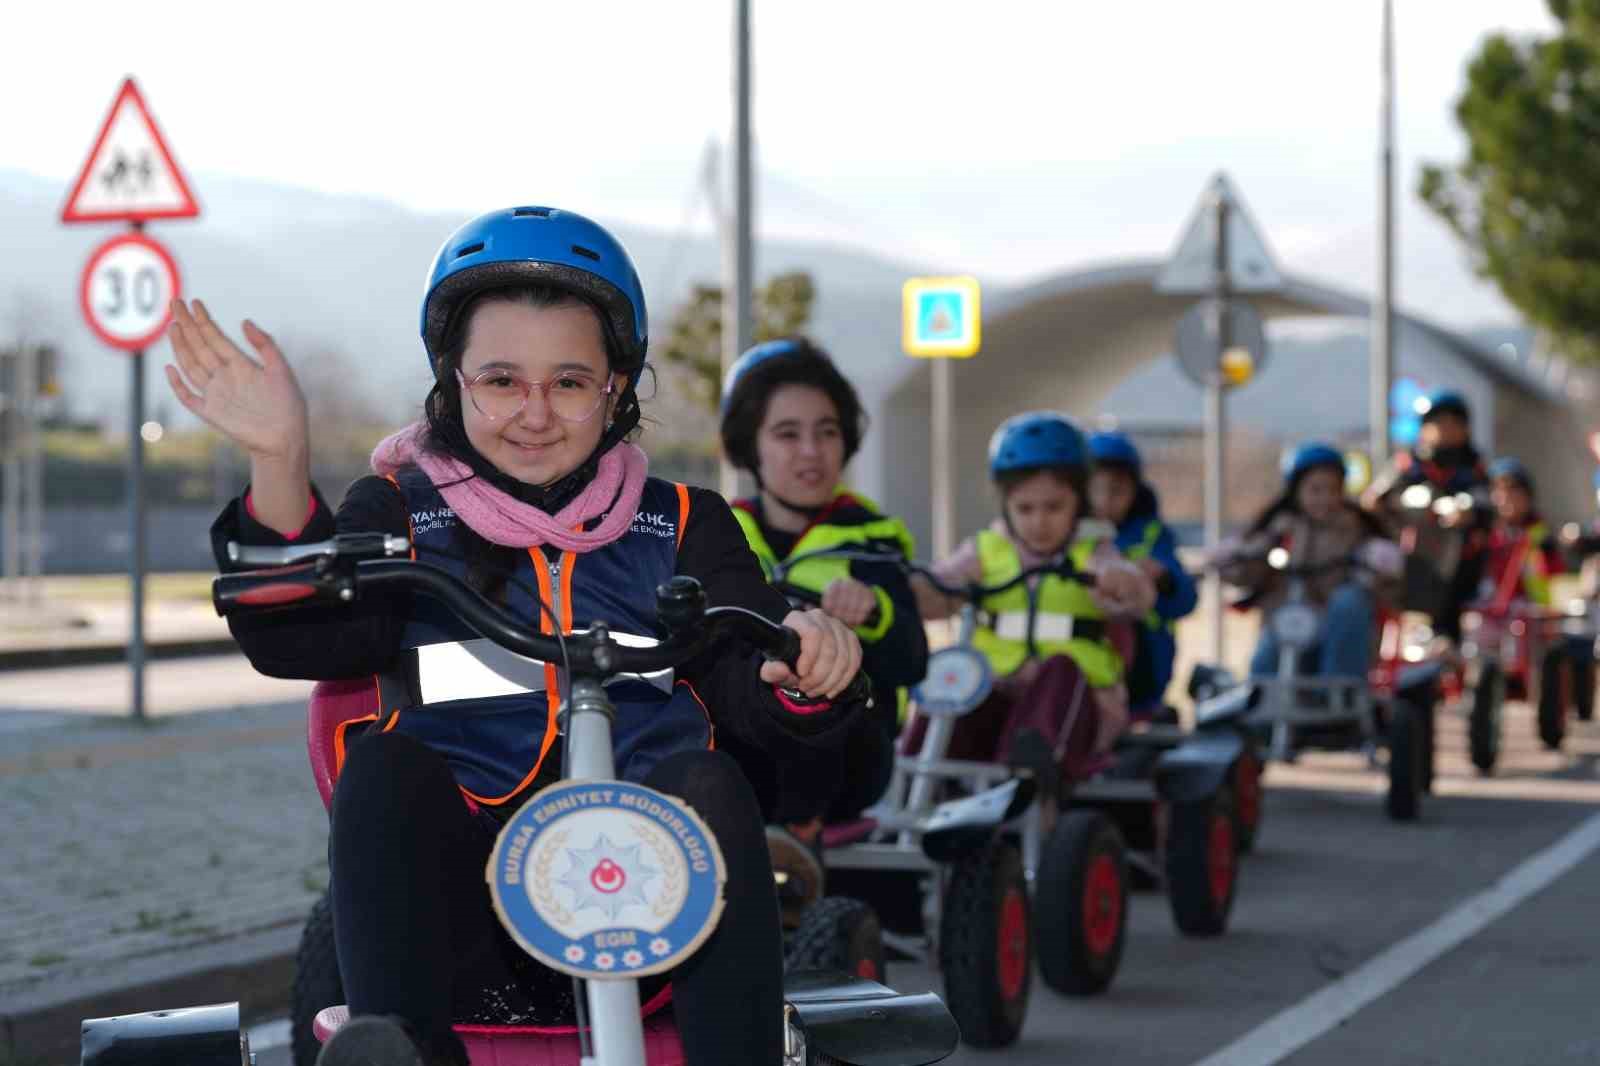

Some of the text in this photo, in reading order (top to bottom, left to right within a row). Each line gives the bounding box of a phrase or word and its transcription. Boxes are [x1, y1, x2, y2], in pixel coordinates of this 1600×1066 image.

[103, 266, 161, 318] 30
[505, 826, 534, 884] BURSA
[535, 791, 613, 823] EMNİYET
[595, 932, 636, 948] EGM
